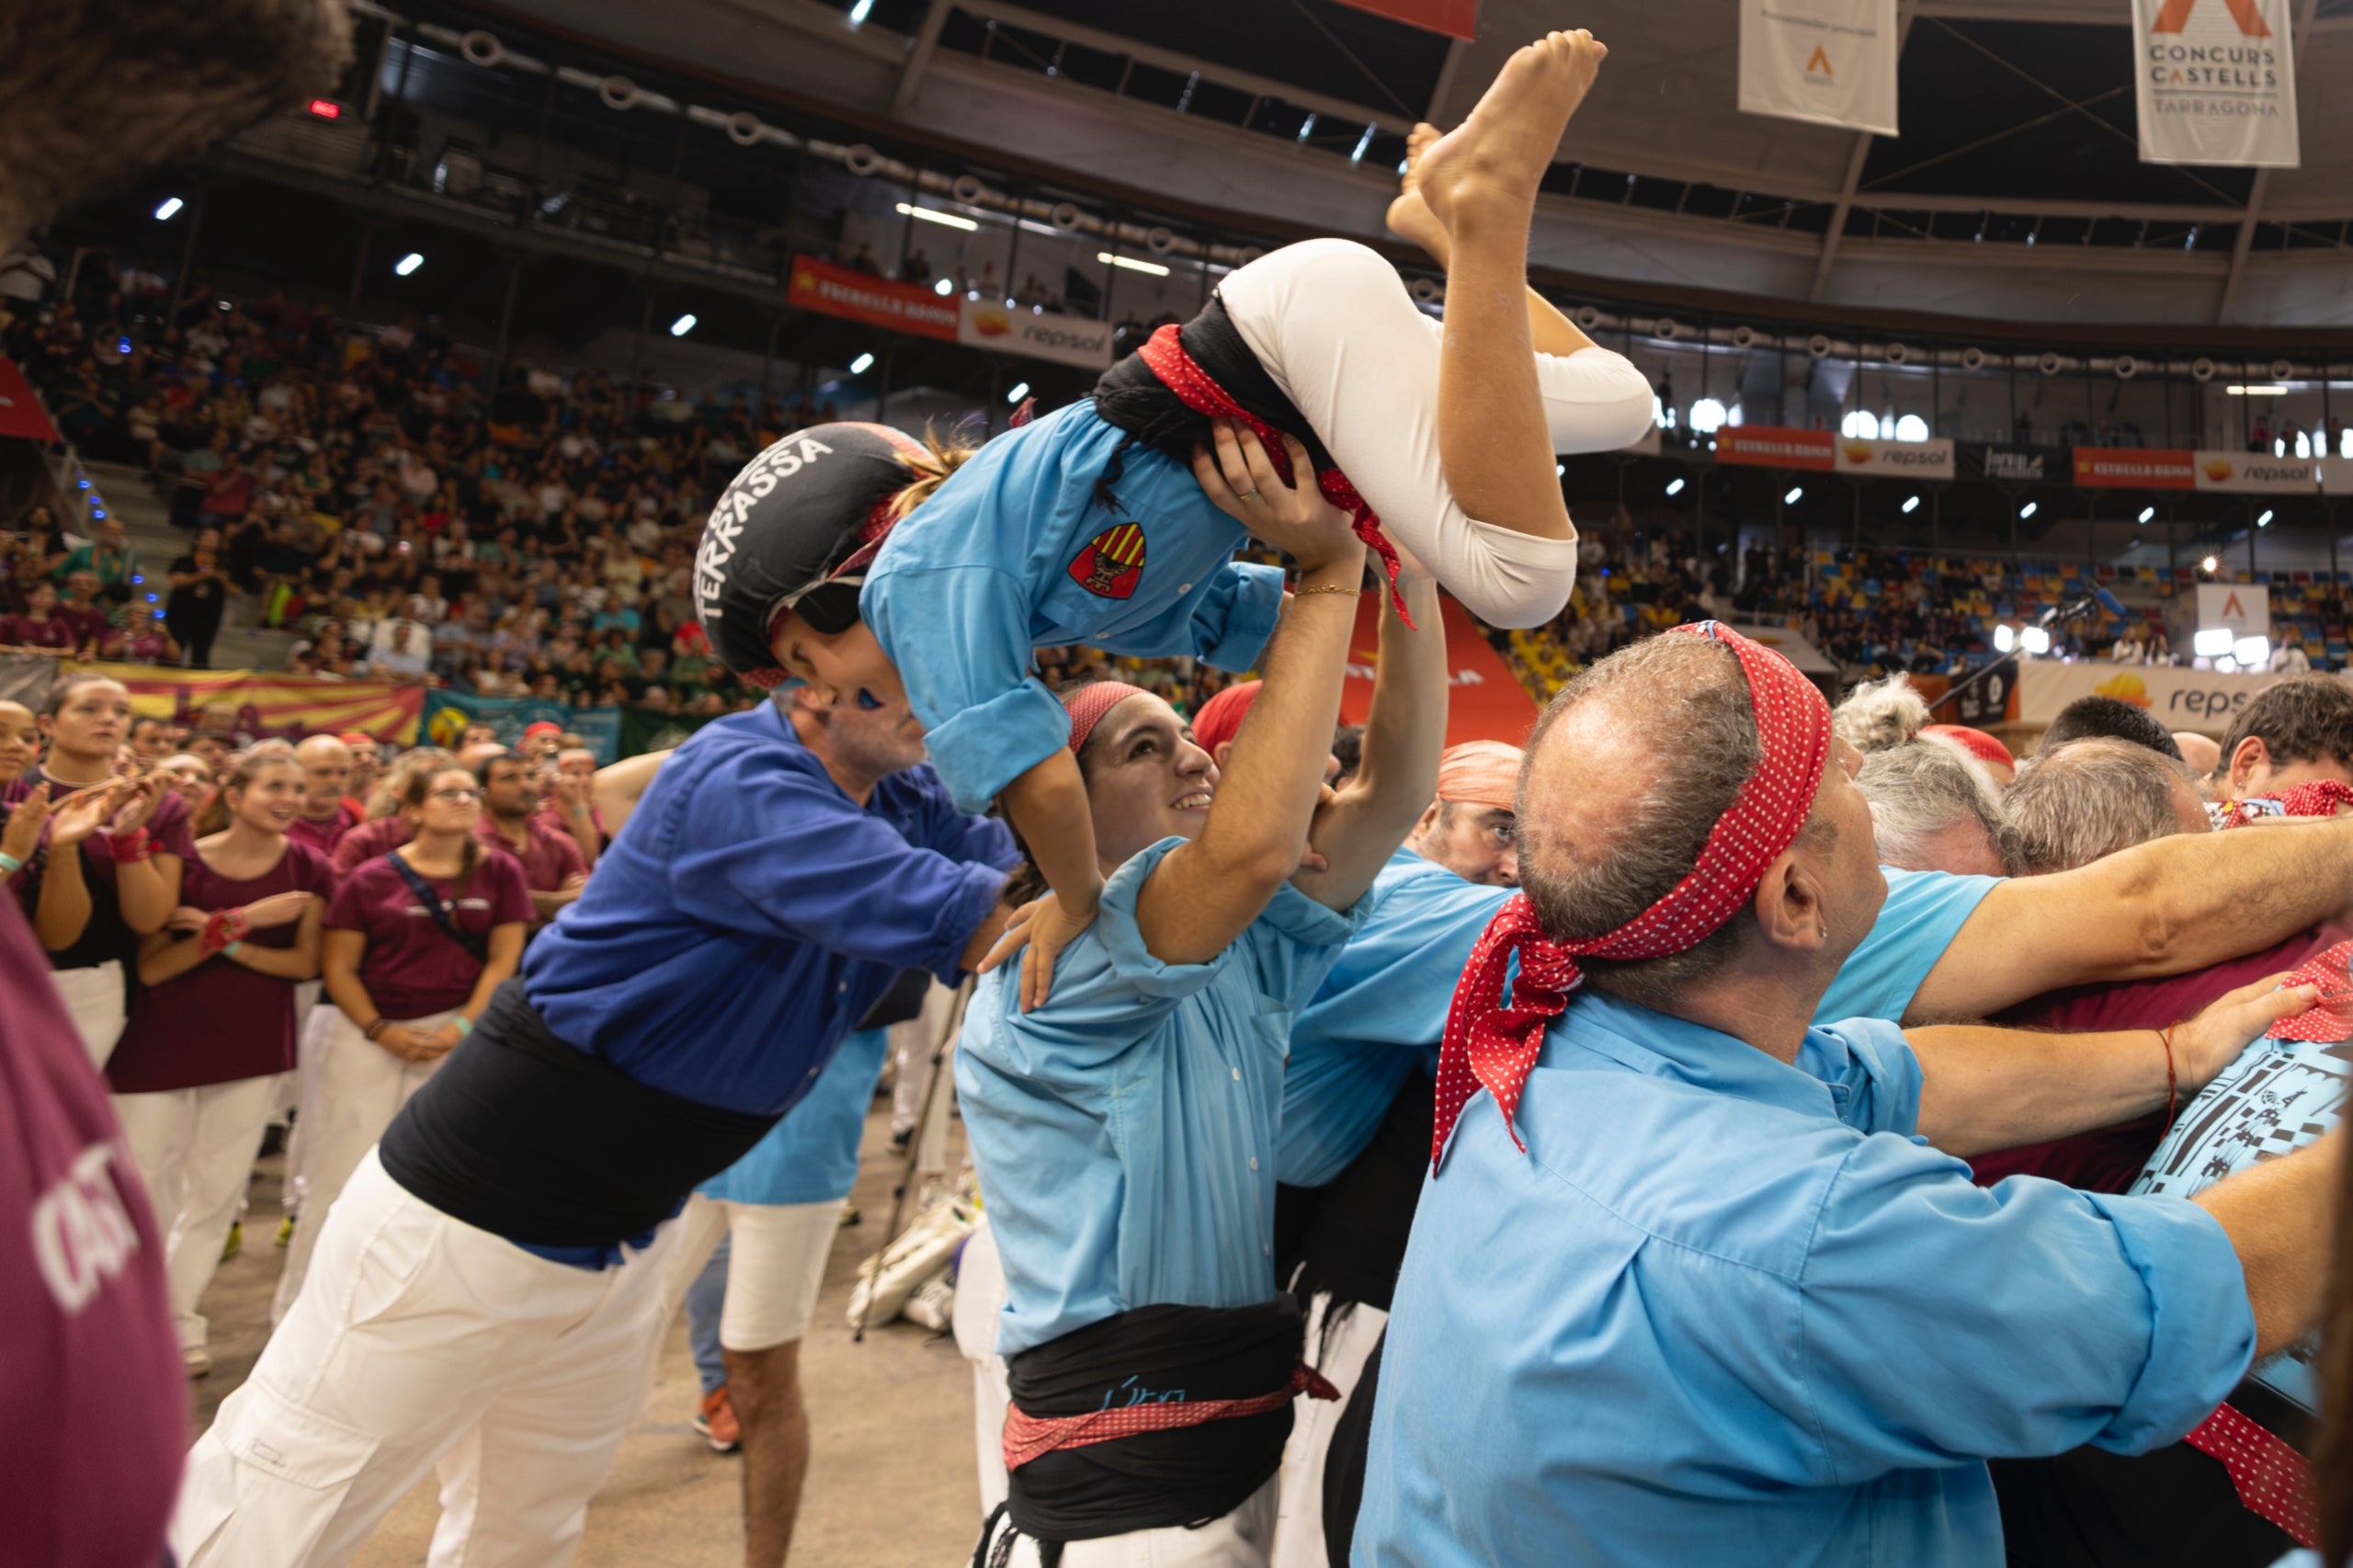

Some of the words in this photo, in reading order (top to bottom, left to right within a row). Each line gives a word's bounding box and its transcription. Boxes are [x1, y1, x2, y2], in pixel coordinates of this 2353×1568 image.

[2149, 45, 2276, 64] CONCURS
[2151, 66, 2277, 87] CASTELLS
[2154, 98, 2279, 117] TARRAGONA
[820, 280, 903, 314] ESTRELLA
[1023, 324, 1105, 352] repsol
[1733, 439, 1791, 456] ESTRELLA
[1881, 448, 1948, 466] repsol
[2093, 462, 2152, 477] ESTRELLA
[2154, 463, 2192, 478] DAMM
[2244, 464, 2310, 483] repsol
[700, 437, 834, 622] TERRASSA
